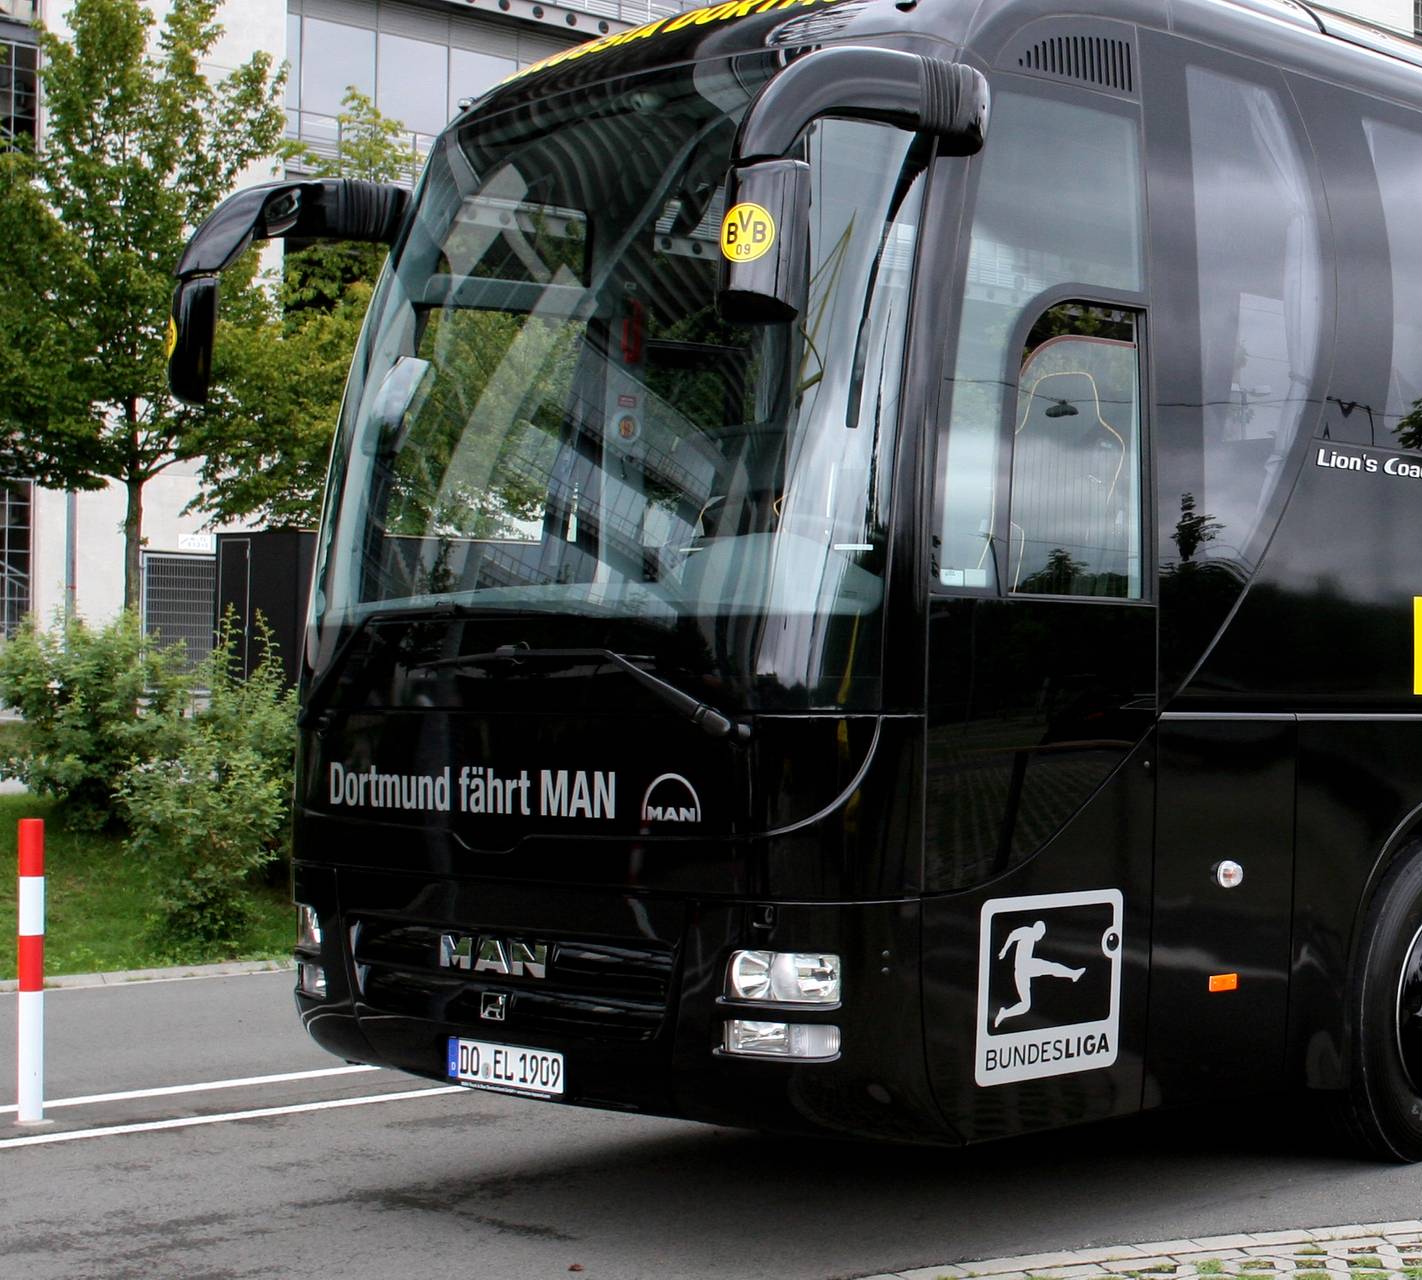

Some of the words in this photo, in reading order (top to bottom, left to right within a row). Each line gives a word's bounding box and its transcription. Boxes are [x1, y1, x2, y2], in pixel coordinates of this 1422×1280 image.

[727, 210, 767, 244] BVB
[736, 243, 751, 256] 09
[1317, 449, 1378, 473] Lion's
[330, 762, 451, 812] Dortmund
[459, 766, 530, 815] fährt
[541, 769, 616, 819] MAN
[646, 806, 697, 822] MAN
[440, 935, 548, 978] MAN
[460, 1045, 480, 1076] DO
[493, 1049, 513, 1081] EL
[519, 1053, 560, 1088] 1909
[985, 1033, 1109, 1071] BUNDESLIGA
